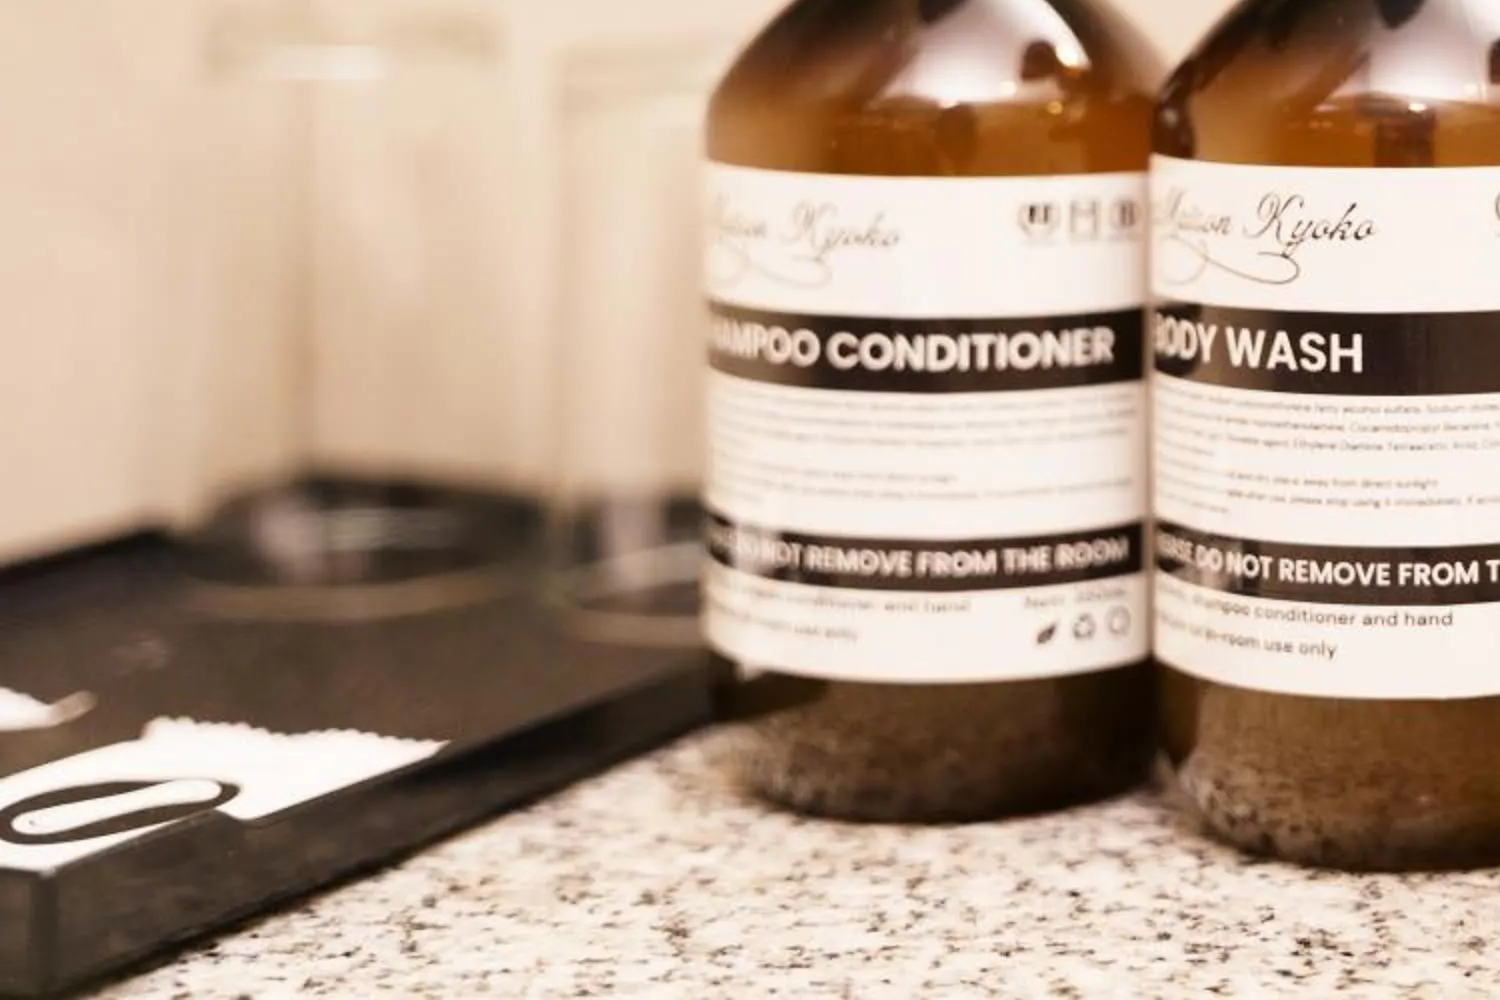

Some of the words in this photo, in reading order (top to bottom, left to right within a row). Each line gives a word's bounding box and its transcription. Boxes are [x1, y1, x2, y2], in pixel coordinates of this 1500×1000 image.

[1242, 193, 1376, 270] Kyoko
[713, 318, 821, 368] AMPOO
[826, 327, 1116, 373] CONDITIONER
[1225, 325, 1363, 373] WASH
[804, 544, 912, 578] REMOVE
[915, 550, 998, 578] FROM
[1002, 545, 1051, 574] THE
[1055, 536, 1130, 569] ROOM
[1195, 545, 1223, 573] DO
[1225, 552, 1274, 580] NOT
[1279, 558, 1391, 587] REMOVE
[1398, 560, 1479, 587] FROM
[1254, 604, 1357, 626] conditioner
[1363, 611, 1398, 627] and
[1404, 611, 1453, 627] hand
[1298, 638, 1338, 660] only
